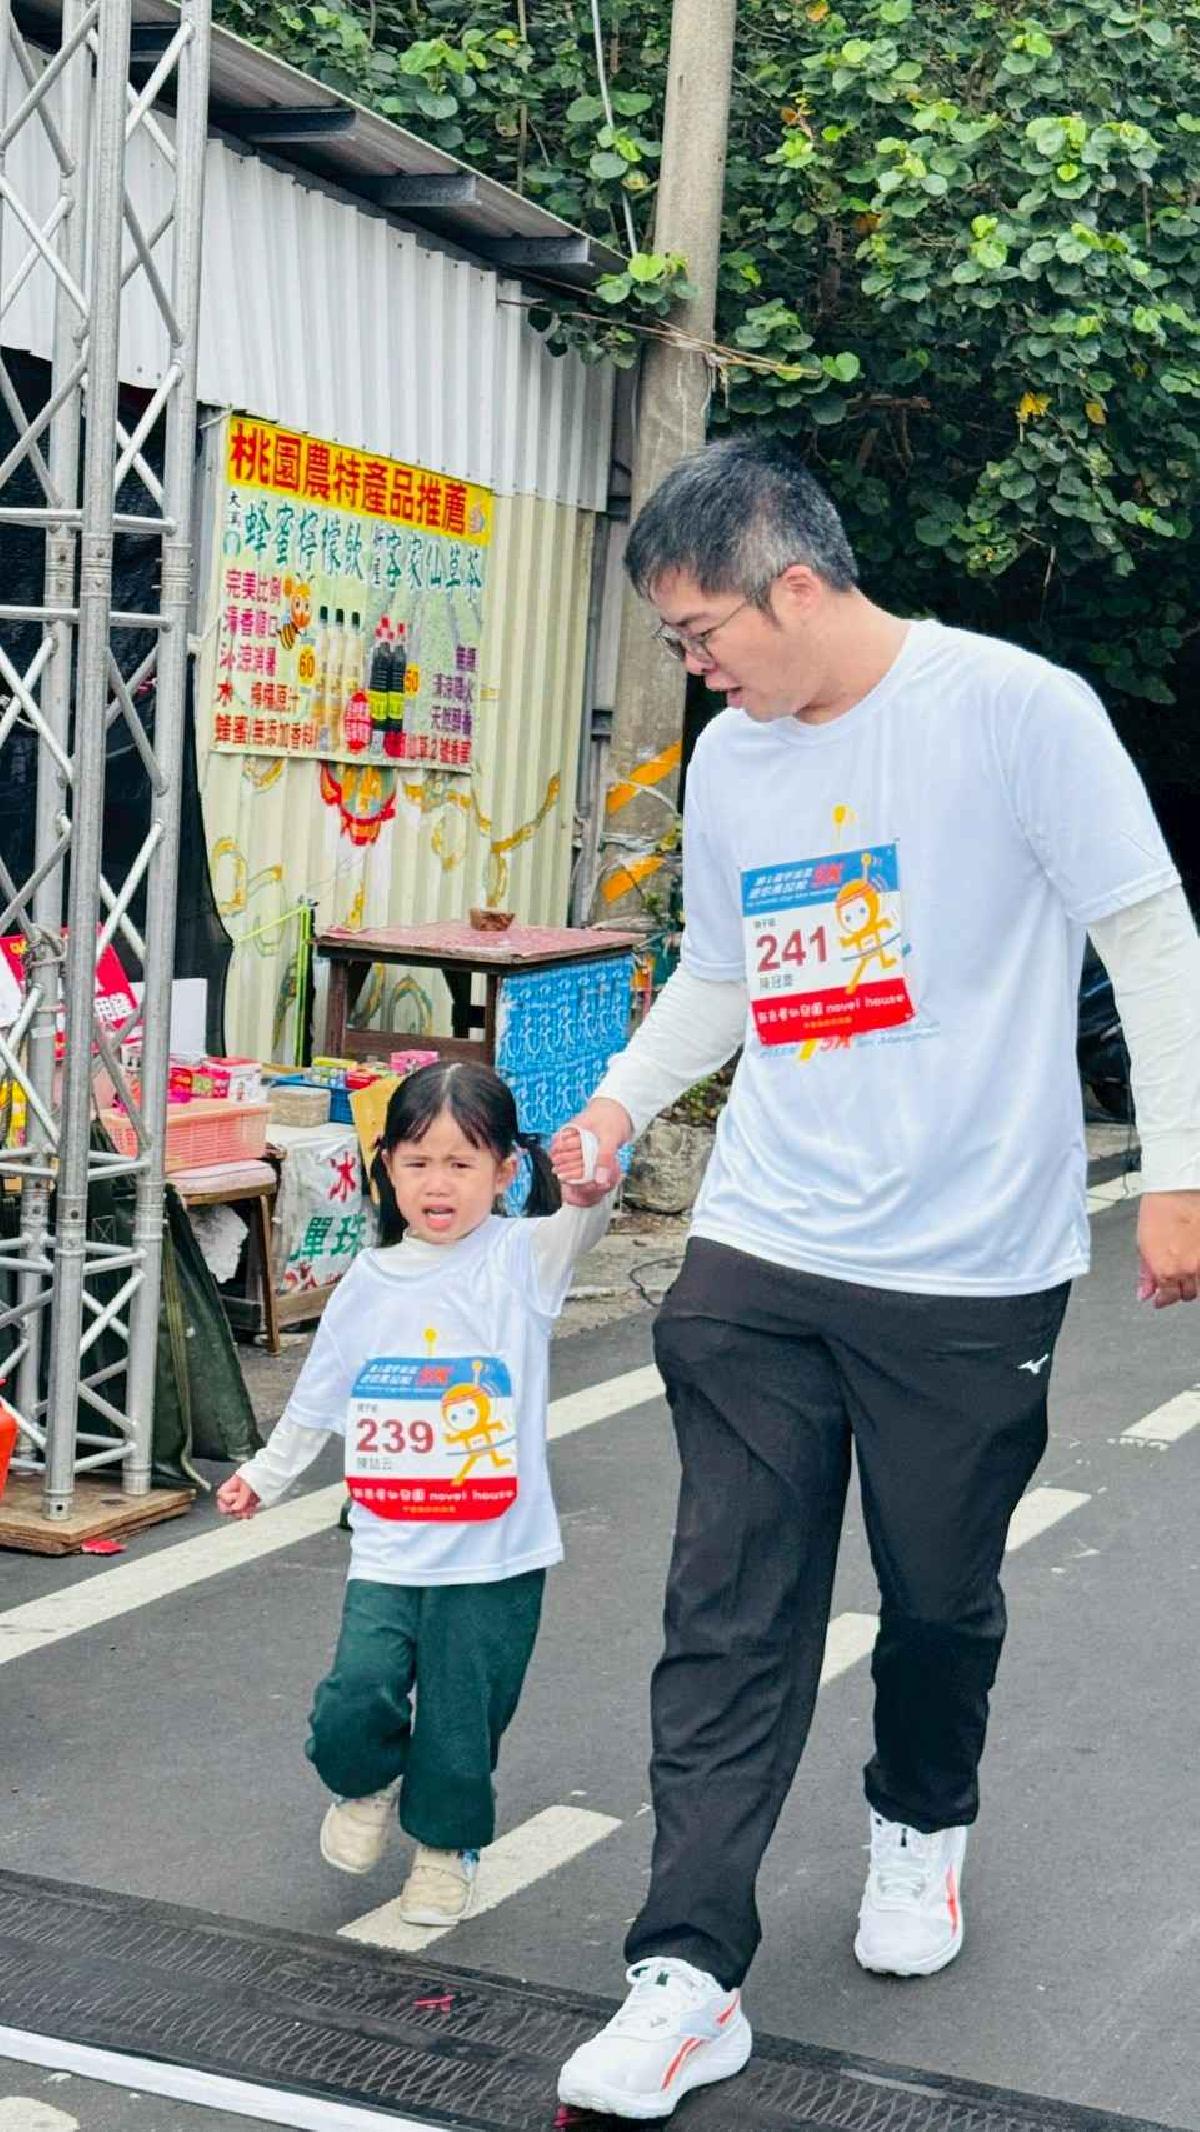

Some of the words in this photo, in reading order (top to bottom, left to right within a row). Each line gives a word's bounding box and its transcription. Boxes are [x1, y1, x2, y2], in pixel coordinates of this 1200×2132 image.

[231, 423, 467, 535] 桃園農特產品推薦
[245, 501, 363, 580] 蜂蜜檸檬飲
[226, 570, 281, 604] 完美比例
[299, 653, 315, 678] 60
[756, 926, 827, 973] 241
[825, 999, 861, 1014] novel
[865, 994, 905, 1008] house
[356, 1418, 434, 1454] 239
[429, 1490, 467, 1503] novel
[472, 1489, 514, 1501] house
